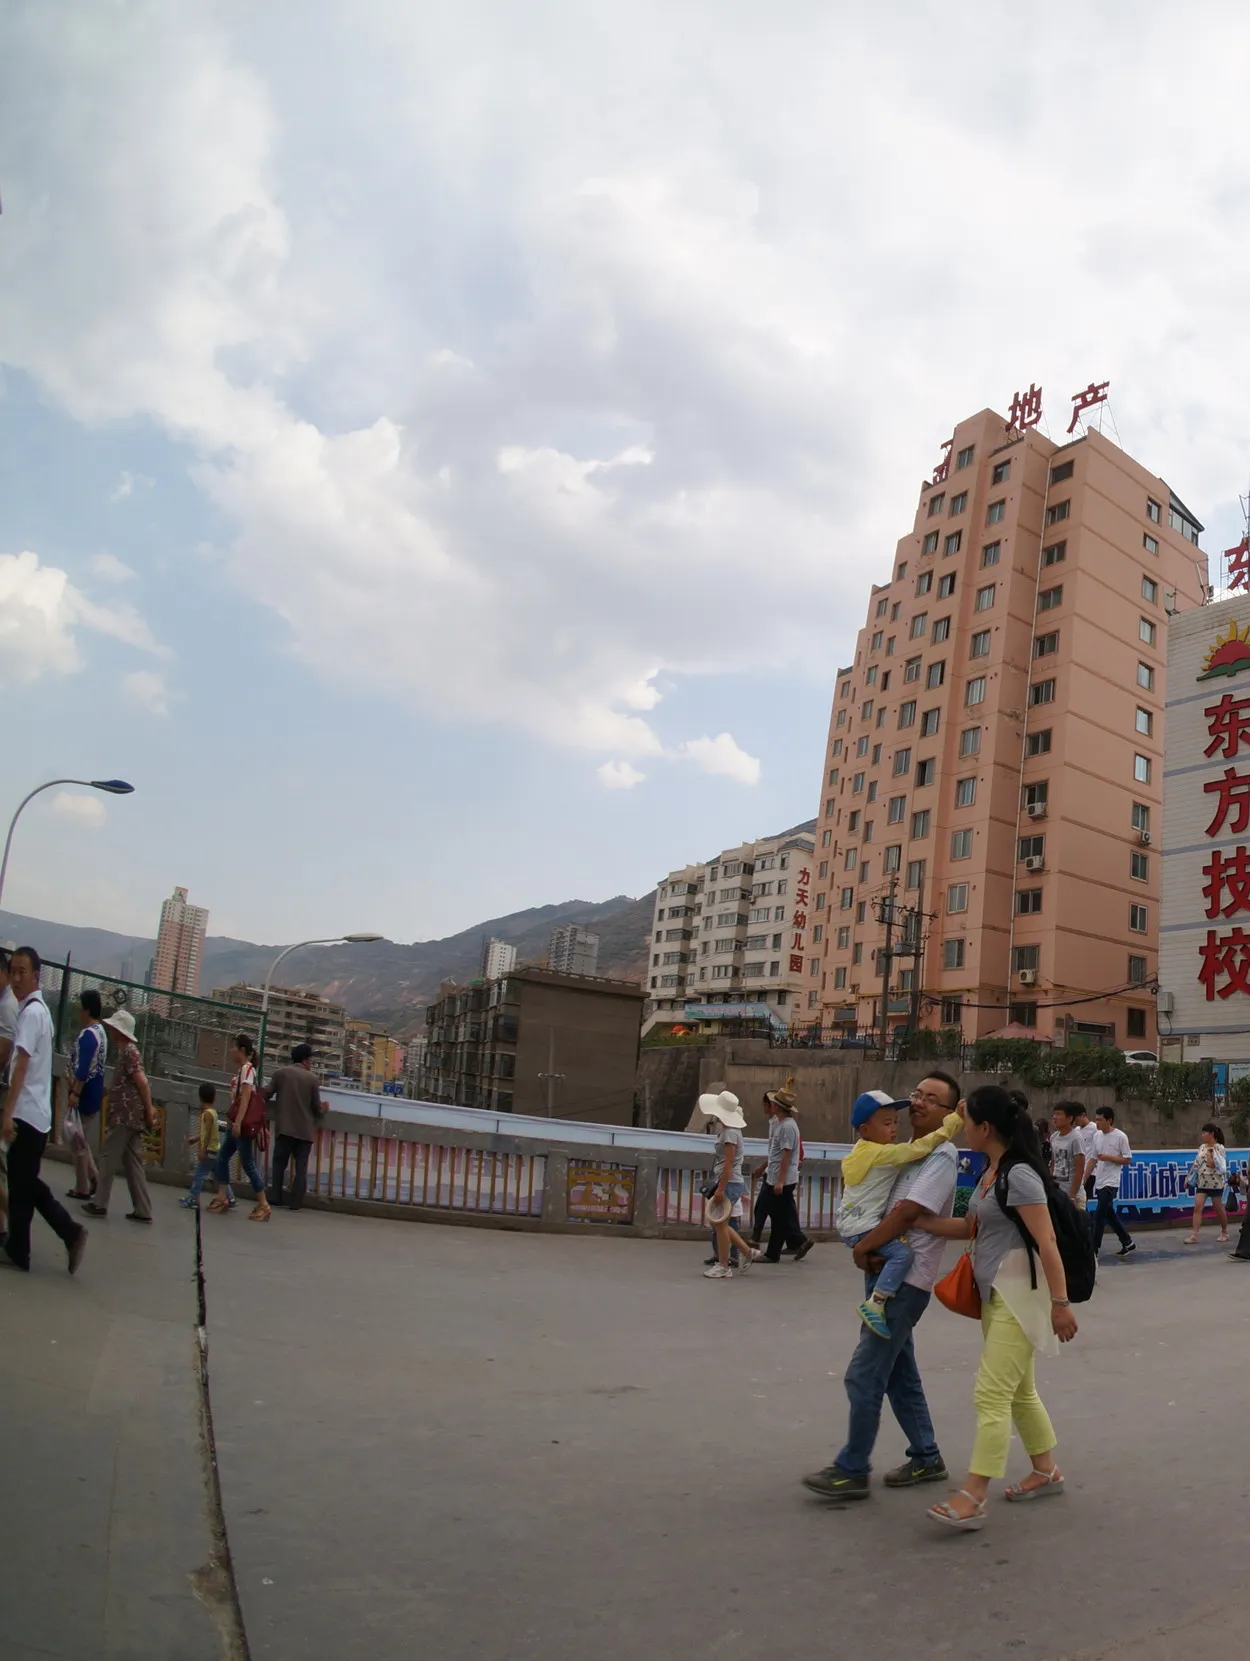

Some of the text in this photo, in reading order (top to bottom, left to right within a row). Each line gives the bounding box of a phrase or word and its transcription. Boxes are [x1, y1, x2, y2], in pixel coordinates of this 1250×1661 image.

[789, 867, 811, 974] 力天幼儿园
